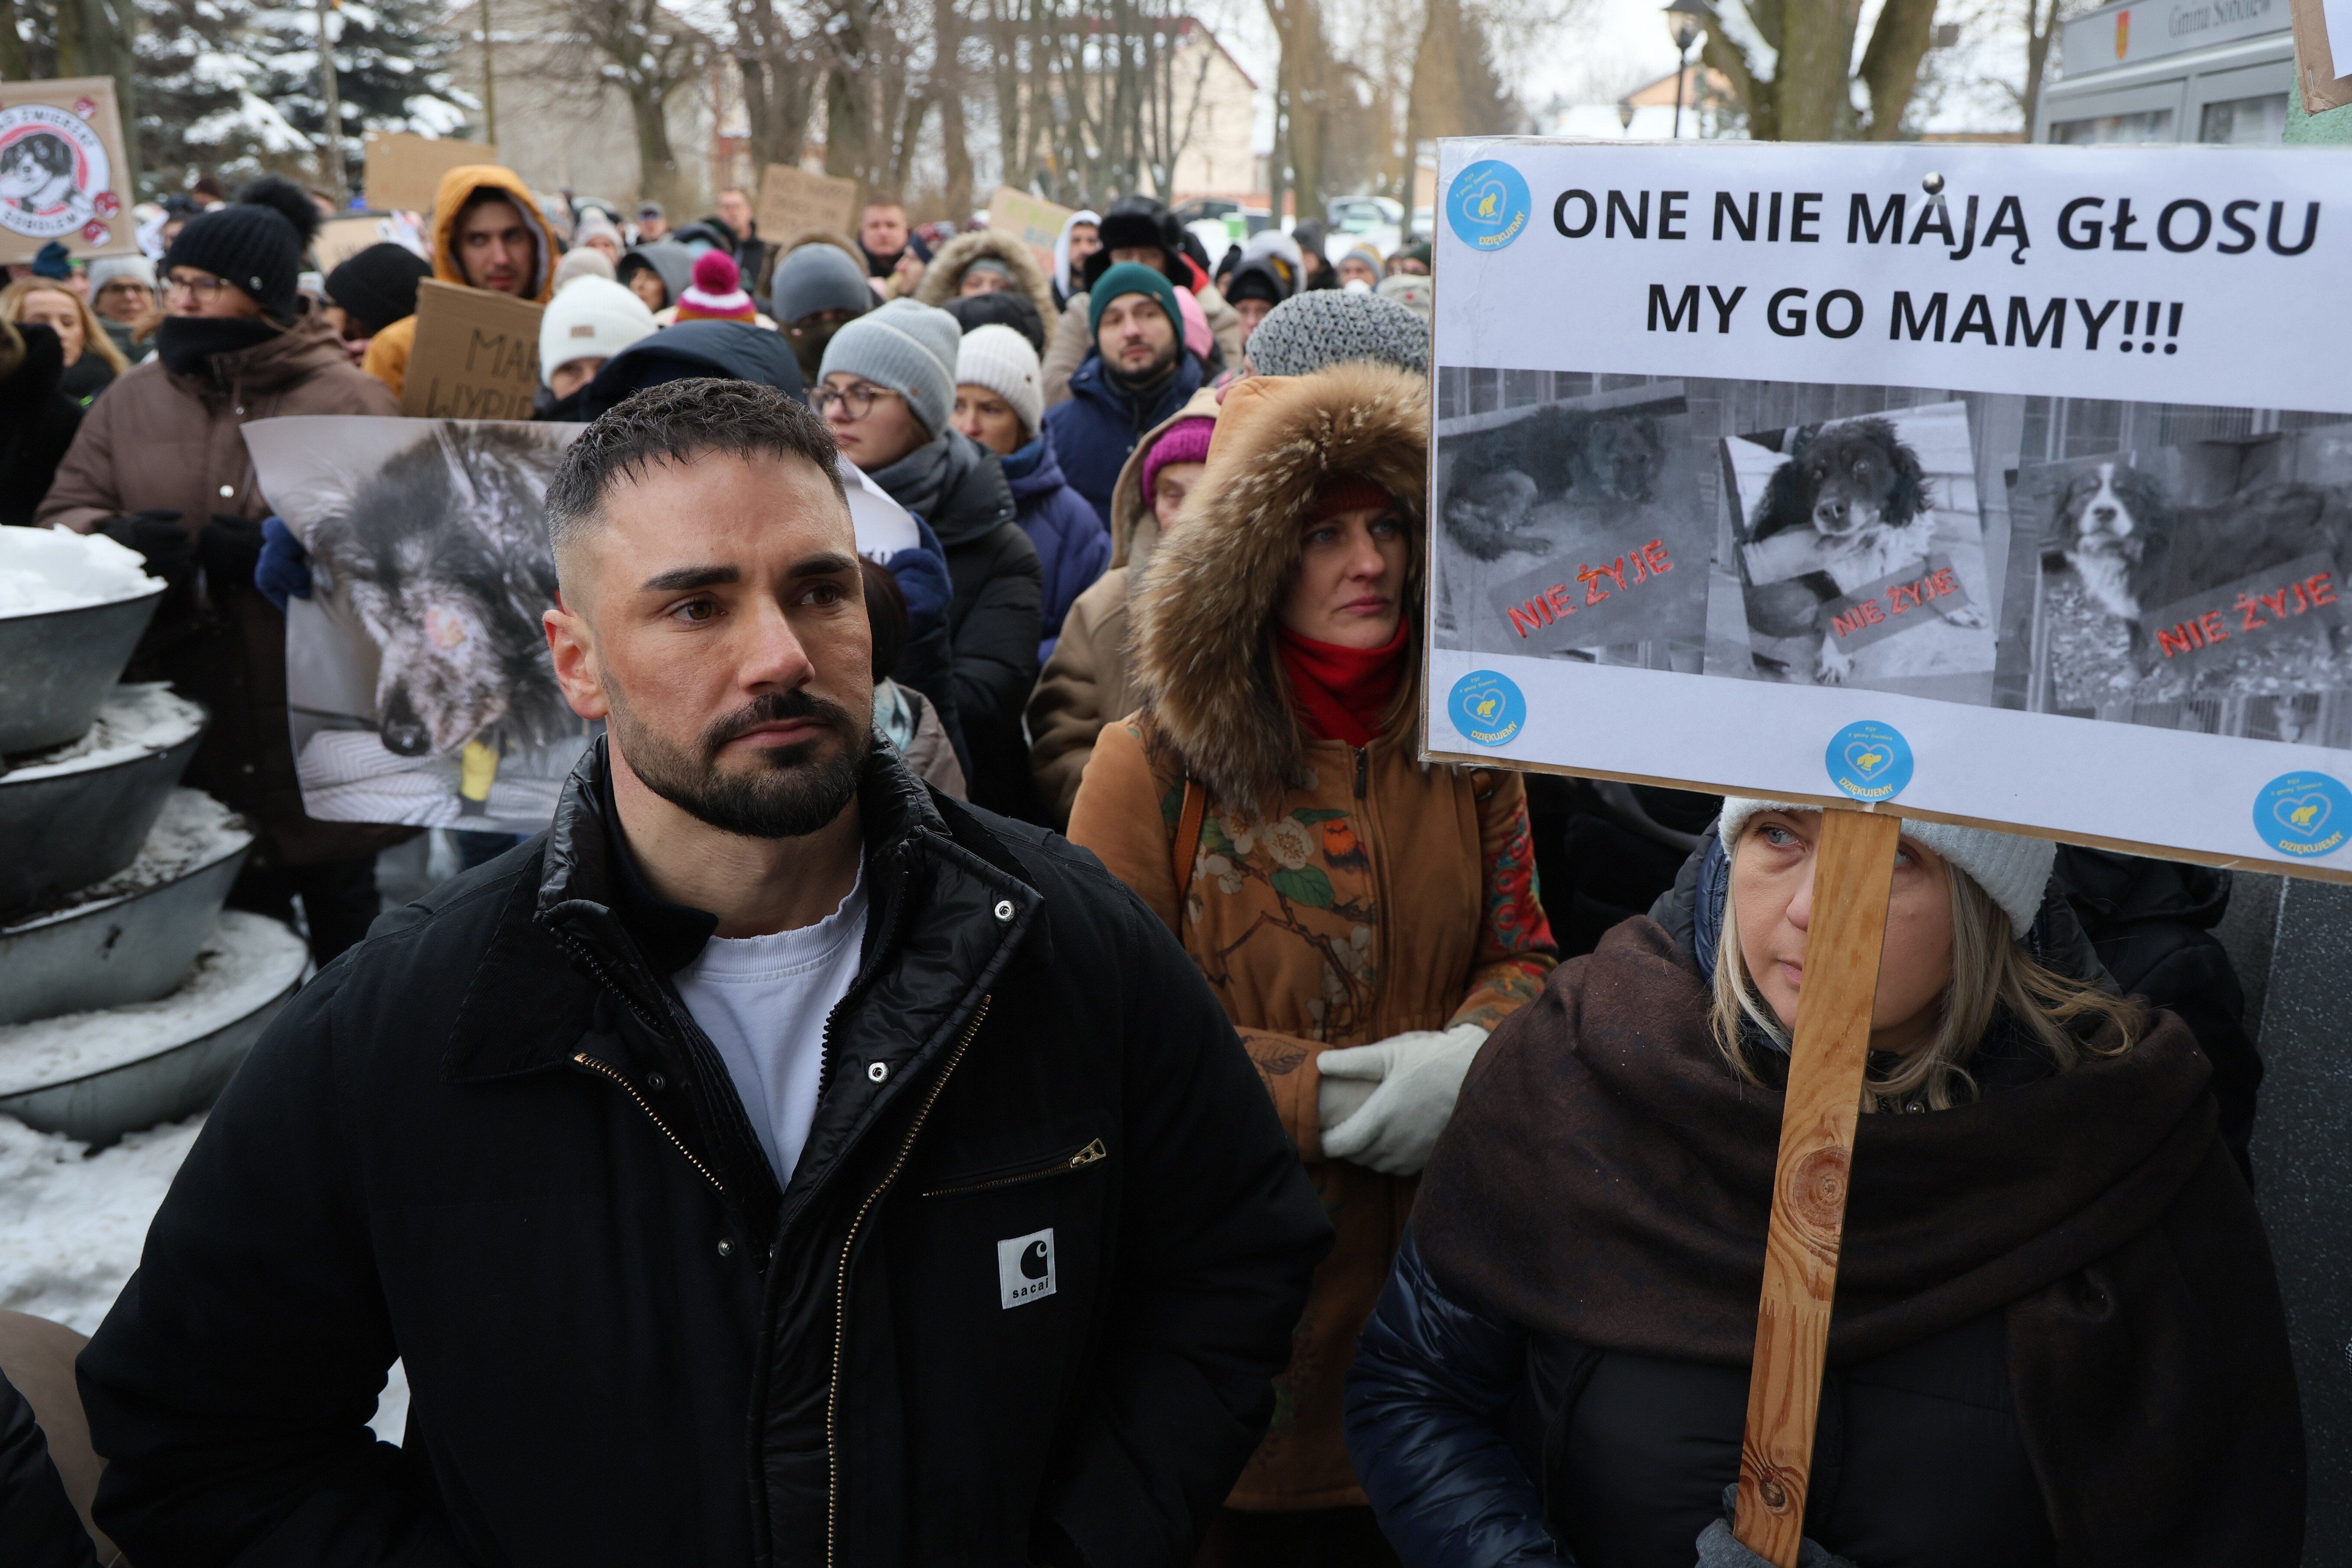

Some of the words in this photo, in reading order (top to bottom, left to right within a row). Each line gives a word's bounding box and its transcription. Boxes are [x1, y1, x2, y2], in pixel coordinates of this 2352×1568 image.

[1479, 211, 1525, 245] DZIĘKUJEMY
[1553, 189, 1689, 240] ONE
[1712, 192, 1823, 242] NIE
[1847, 193, 2030, 265] MAJĄ
[2058, 197, 2320, 256] GŁOSU
[1647, 284, 1747, 333] MY
[1767, 288, 1864, 339] GO
[1889, 291, 2184, 355] MAMY!!!
[1507, 585, 1576, 638] NIE
[1576, 539, 1673, 606] ŻYJE
[1832, 599, 1886, 637] NIE
[2156, 611, 2229, 657] NIE
[2234, 572, 2338, 631] ŻYJE
[1471, 721, 1517, 743] DZIĘKUJEMY
[1839, 777, 1893, 797] DZIĘKUJEMY
[2279, 831, 2343, 855] DZIĘKUJEMY
[1012, 1277, 1049, 1298] sacai
